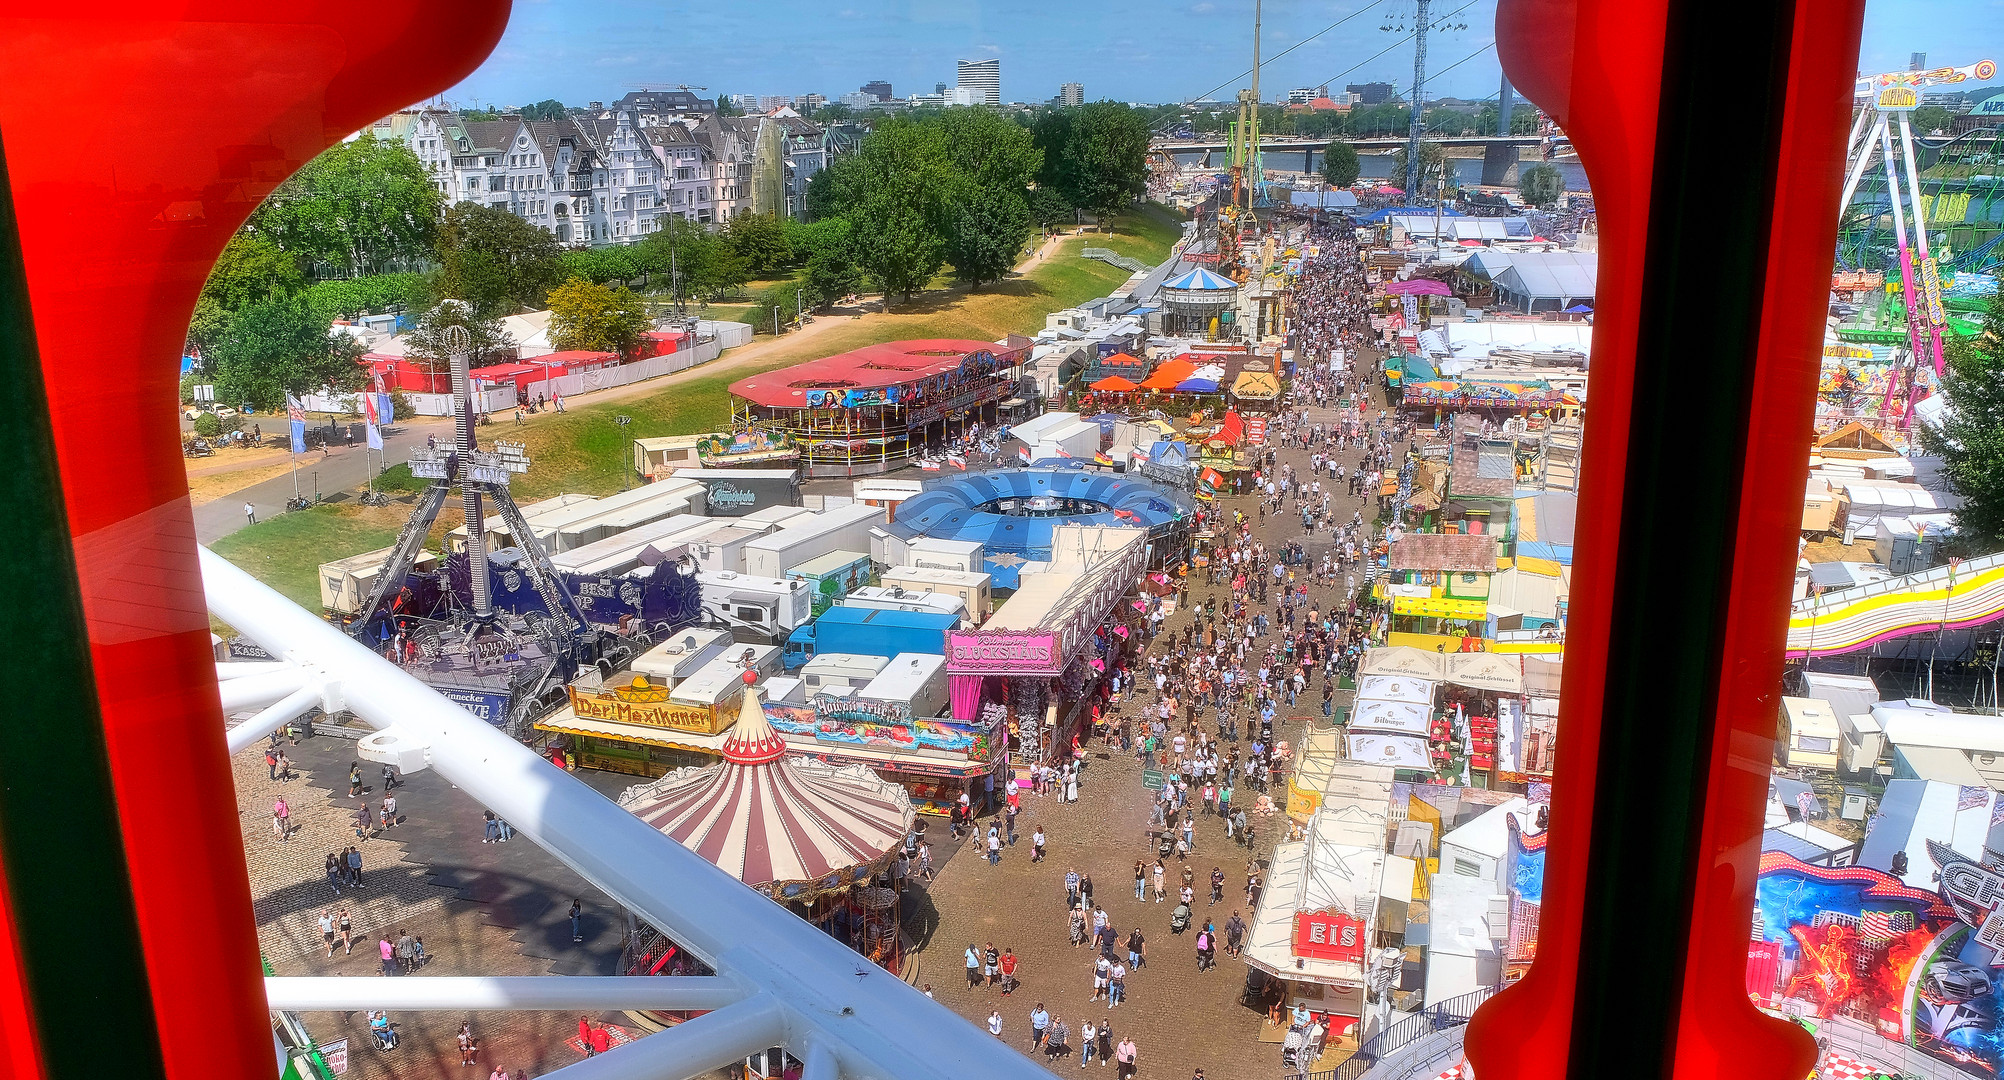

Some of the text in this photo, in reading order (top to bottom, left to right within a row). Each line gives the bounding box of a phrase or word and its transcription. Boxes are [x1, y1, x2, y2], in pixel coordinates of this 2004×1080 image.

[1880, 88, 1916, 106] INFINITY
[579, 582, 617, 599] BEST
[233, 645, 268, 658] KASSE
[577, 697, 711, 727] Der Mexikaner
[816, 697, 858, 716] Hawaii
[1308, 921, 1357, 947] EIS
